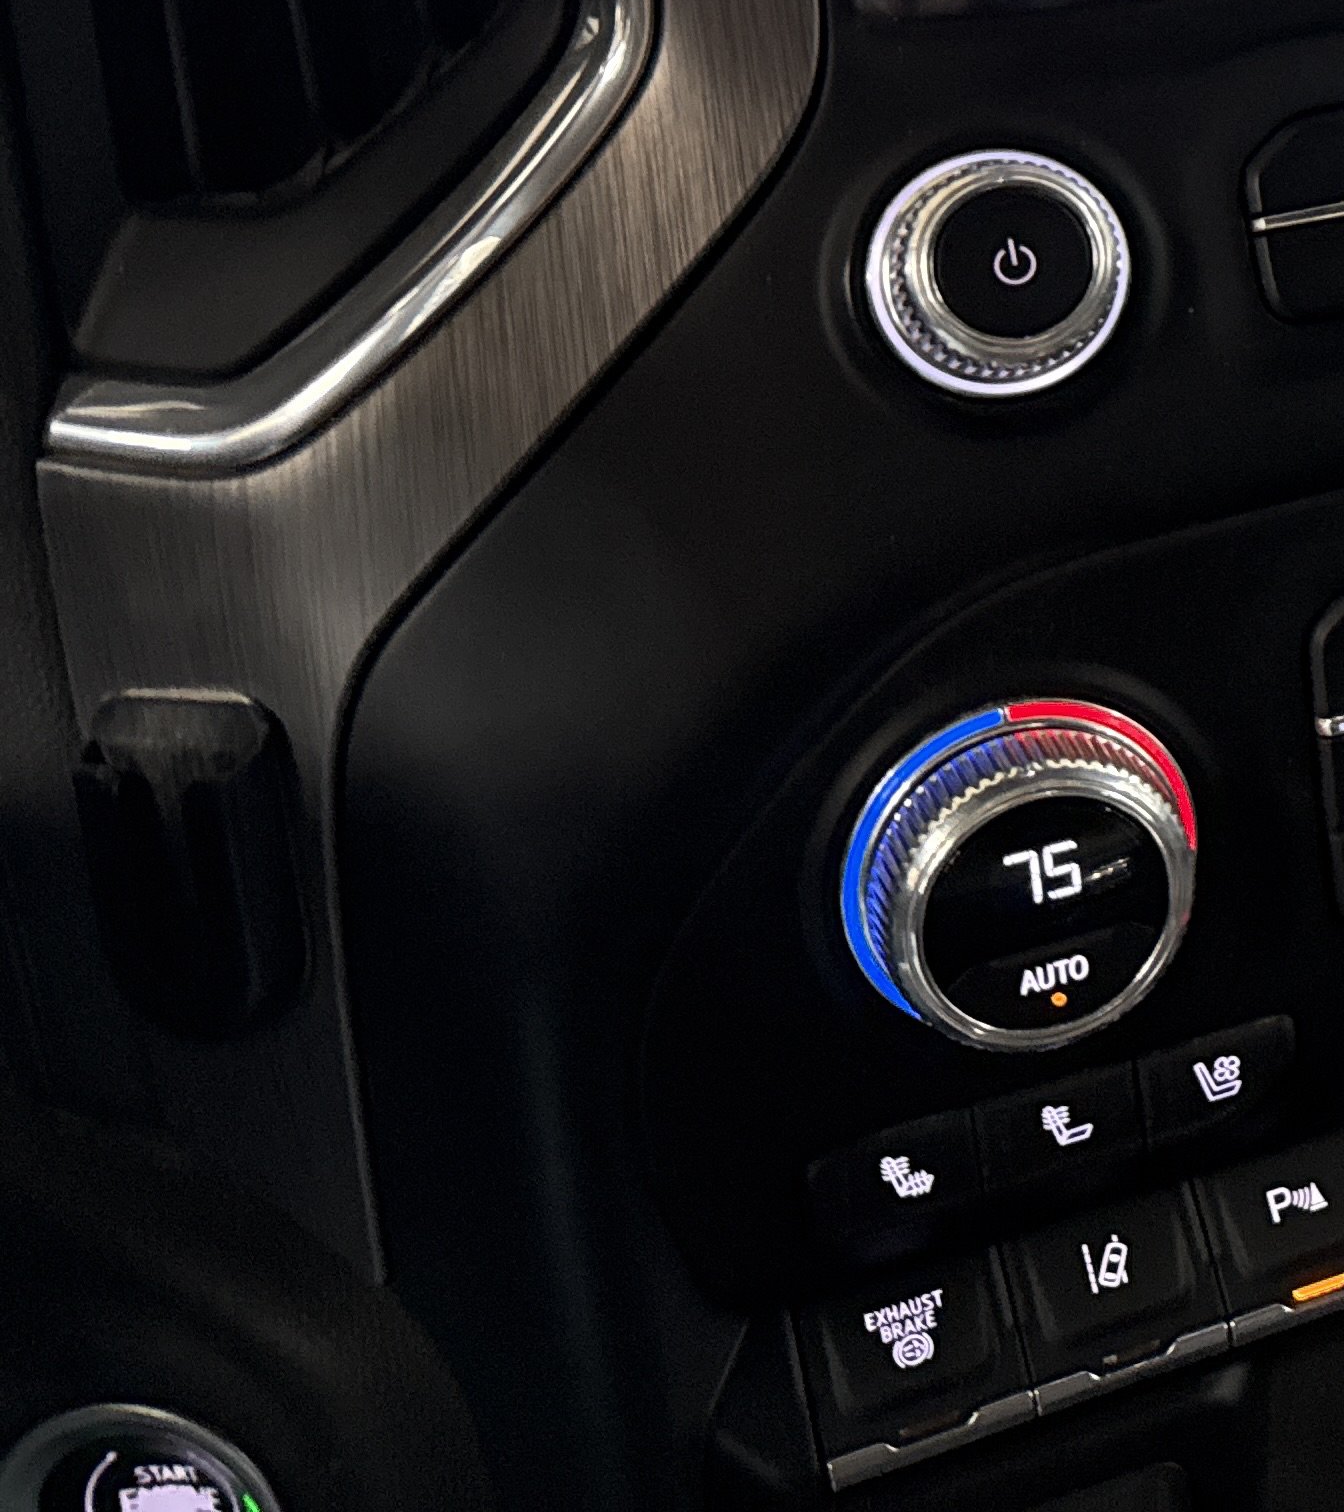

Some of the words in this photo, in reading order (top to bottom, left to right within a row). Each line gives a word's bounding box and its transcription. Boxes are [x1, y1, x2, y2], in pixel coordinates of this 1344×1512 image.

[1002, 839, 1082, 904] 75
[1020, 954, 1090, 997] AUTO
[864, 1289, 943, 1332] EXHAUST
[880, 1308, 938, 1344] BRAKE
[134, 1464, 198, 1484] START
